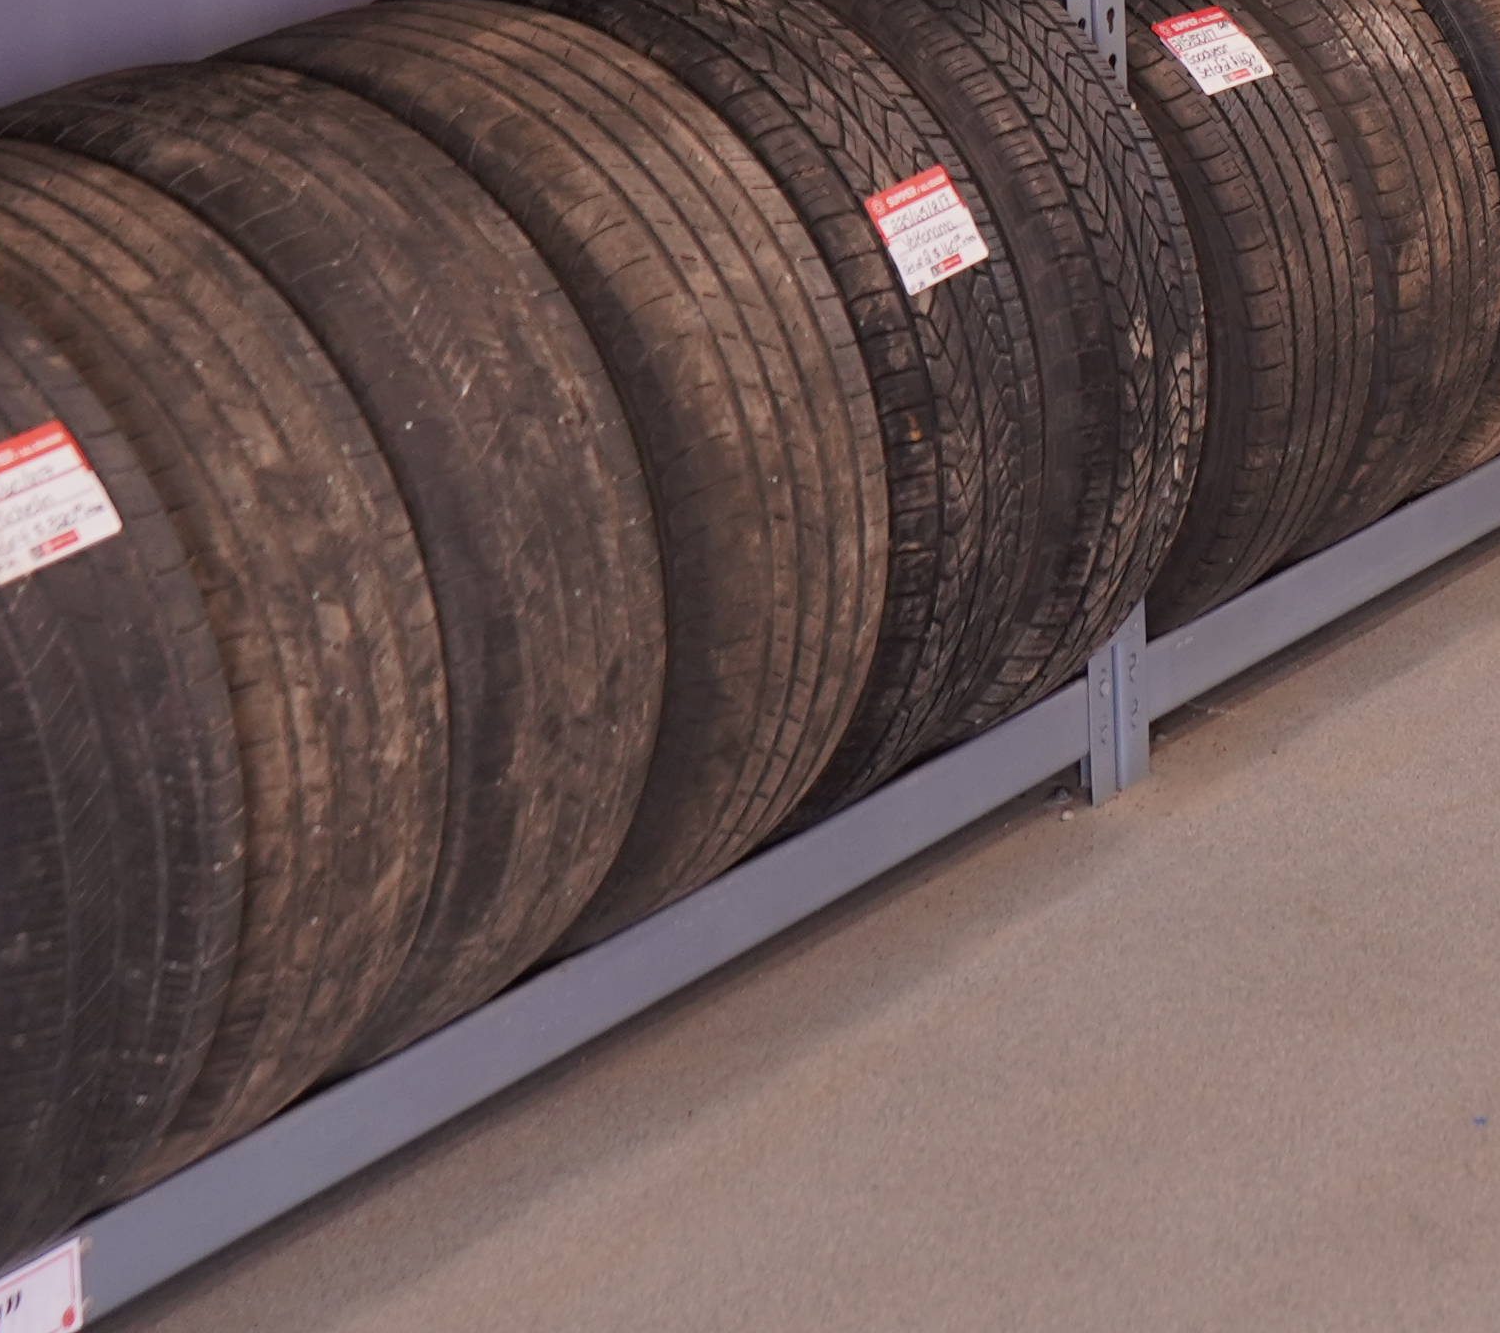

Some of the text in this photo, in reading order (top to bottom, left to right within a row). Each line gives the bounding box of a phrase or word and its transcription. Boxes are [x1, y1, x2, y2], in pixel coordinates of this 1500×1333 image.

[1171, 18, 1199, 32] SUMMER
[886, 186, 918, 208] SUMMER
[900, 221, 957, 252] Yokohama
